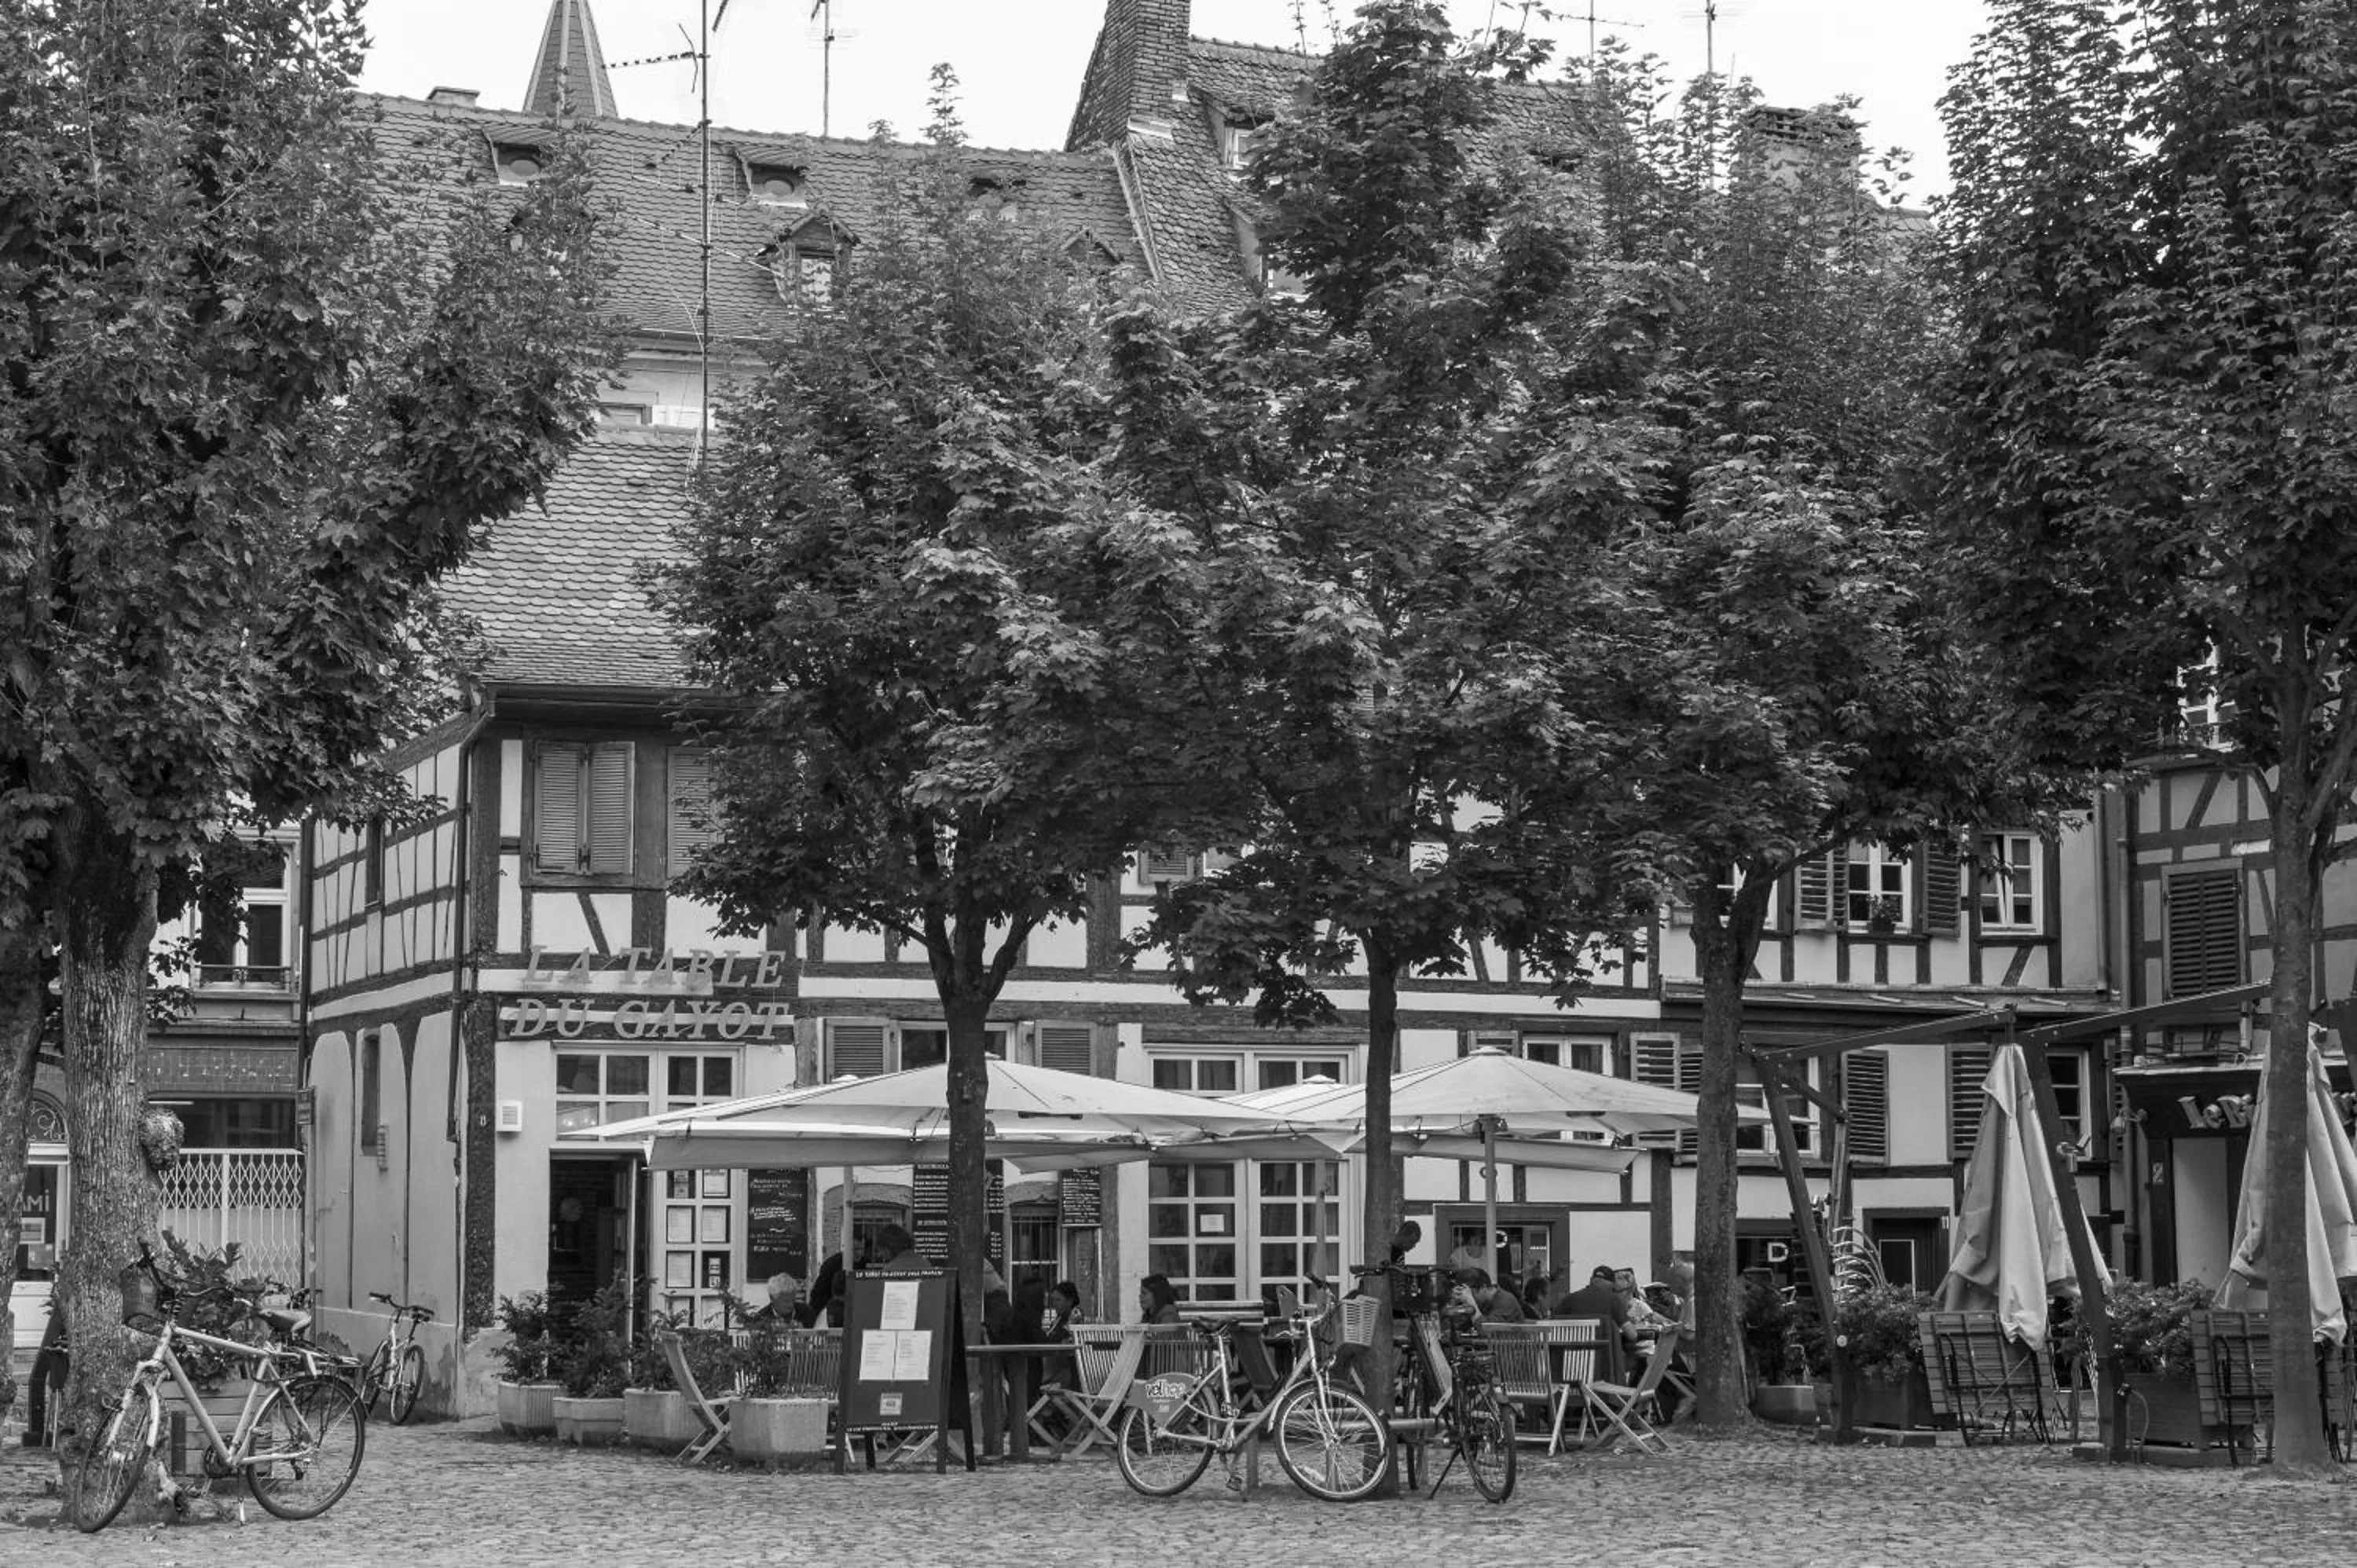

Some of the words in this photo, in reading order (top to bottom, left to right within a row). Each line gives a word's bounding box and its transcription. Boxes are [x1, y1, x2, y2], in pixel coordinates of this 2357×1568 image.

[522, 944, 592, 984] LA
[618, 947, 786, 987] TABLE
[509, 998, 596, 1037] DU
[613, 999, 790, 1039] GAYOT
